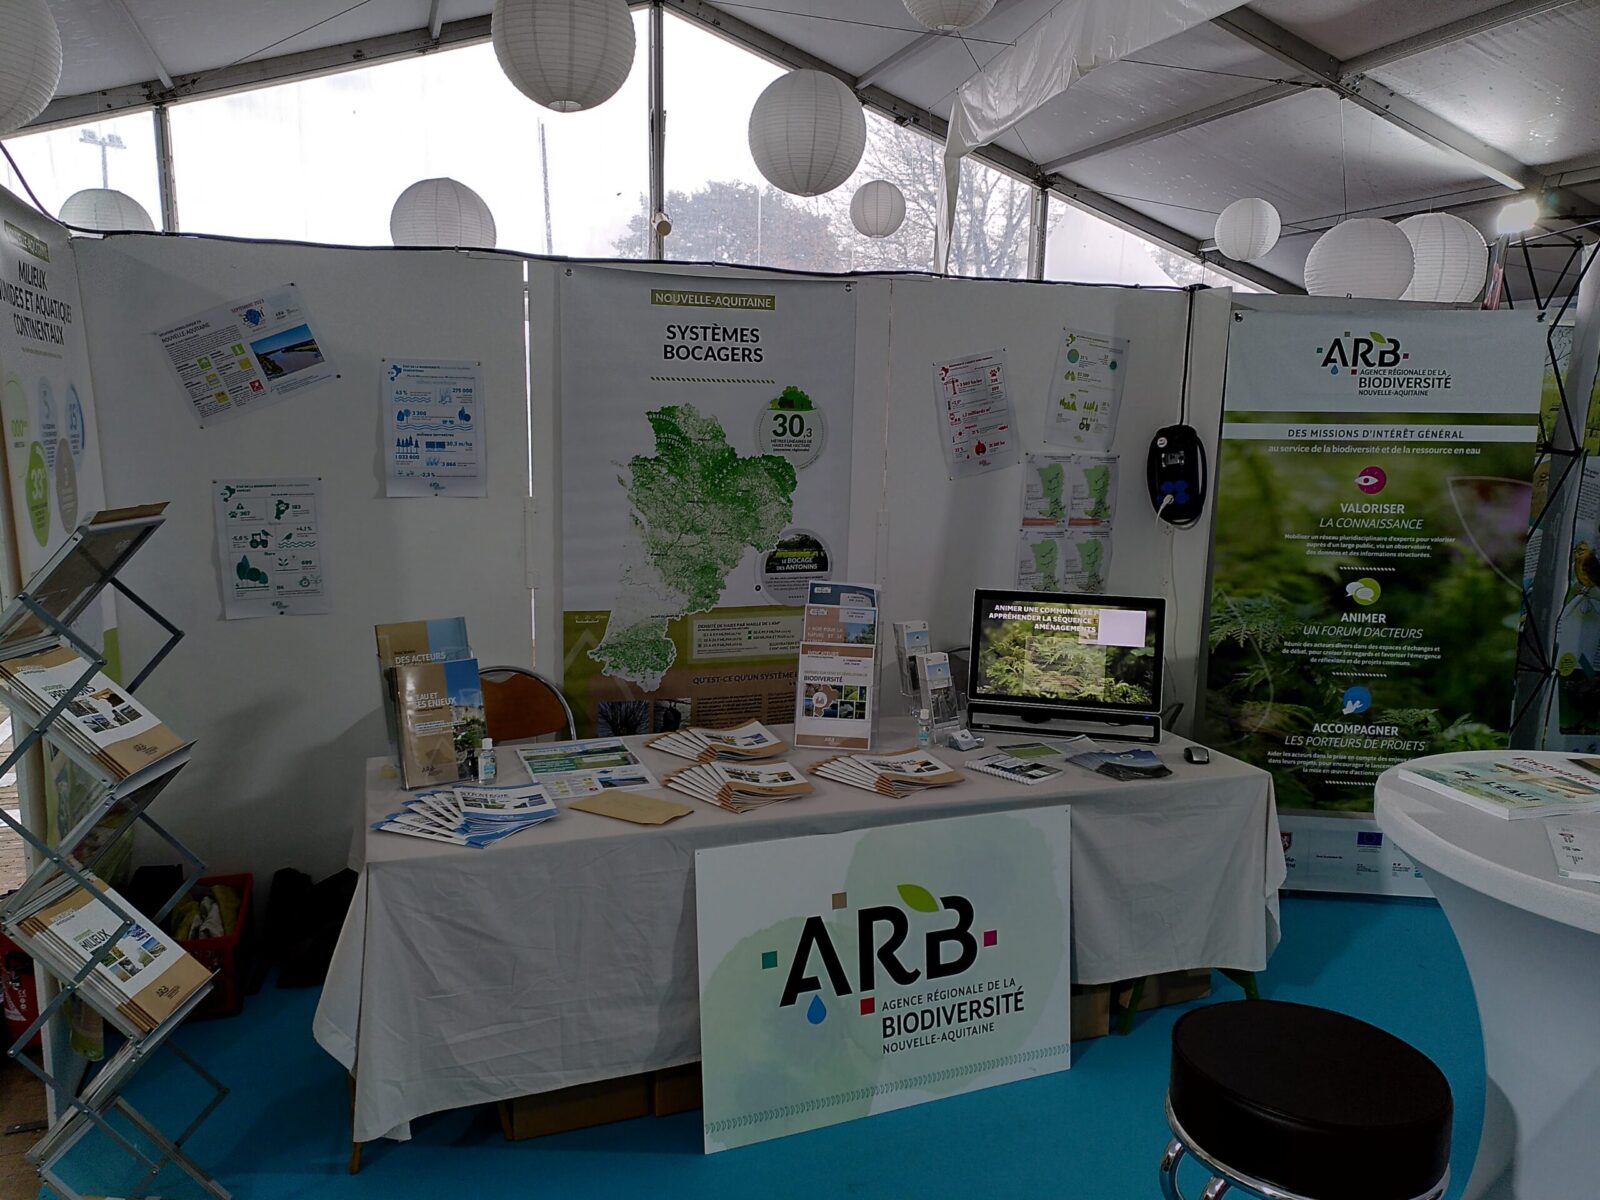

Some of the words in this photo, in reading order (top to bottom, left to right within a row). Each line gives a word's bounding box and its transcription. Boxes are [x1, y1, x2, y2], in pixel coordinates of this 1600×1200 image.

[18, 260, 48, 291] MILIEUX
[25, 289, 34, 312] ET
[655, 293, 772, 308] NOUVELLE-AQUITAINE
[13, 313, 64, 346] CONTINENTAUX
[666, 323, 760, 343] SYSTÈMES
[663, 345, 763, 363] BOCAGERS
[1321, 338, 1401, 367] ARB
[1388, 367, 1427, 377] RÉGIONALE
[1358, 374, 1452, 390] BIODIVERSITÉ
[1358, 389, 1429, 397] NOUVELLE-AQUITAINE
[772, 413, 813, 438] 30,3
[1287, 429, 1308, 438] DES
[1310, 429, 1360, 439] MISSIONS
[1362, 428, 1416, 439] D'INTÉRÊT
[1418, 428, 1465, 439] GÉNÉRAL
[1280, 445, 1310, 453] service
[1311, 445, 1322, 453] de
[1323, 445, 1331, 453] la
[1332, 445, 1380, 454] biodiversité
[1382, 446, 1390, 454] et
[1391, 446, 1401, 454] de
[1403, 446, 1411, 454] la
[1340, 503, 1405, 514] VALORISER
[1319, 518, 1334, 528] LA
[1336, 518, 1424, 530] CONNAISSANCE
[994, 604, 1022, 612] ANIMER
[989, 612, 1041, 621] APPRÉHENDER
[1053, 615, 1092, 624] SÉQUENCE
[1341, 613, 1387, 624] ANIMER
[1034, 623, 1097, 632] AMÉNAGEMENTS
[1303, 626, 1320, 636] UN
[1321, 626, 1362, 637] FORUM
[1363, 627, 1424, 639] D'ACTEURS
[395, 656, 410, 664] DES
[411, 651, 446, 662] ACTEURS
[693, 675, 734, 685] QU'EST-CE
[734, 673, 759, 682] QU'UN
[759, 671, 794, 680] SYSTÈME
[803, 675, 843, 683] BIODIVERSITÉ
[427, 696, 457, 707] ENJEUX
[1312, 723, 1399, 737] ACCOMPAGNER
[1284, 736, 1304, 746] LES
[1305, 736, 1362, 749] PORTEURS
[1363, 738, 1379, 750] DE
[1380, 739, 1426, 751] PROJETS
[80, 928, 112, 952] MILIEUX
[779, 895, 978, 1008] ARB
[882, 994, 924, 1011] AGENCE
[927, 983, 984, 1003] RÉGIONALE
[987, 979, 1001, 991] DE
[1003, 977, 1016, 988] LA
[882, 985, 1025, 1039] BIODIVERSITÉ
[882, 1022, 995, 1055] NOUVELLE-AQUITAINE
